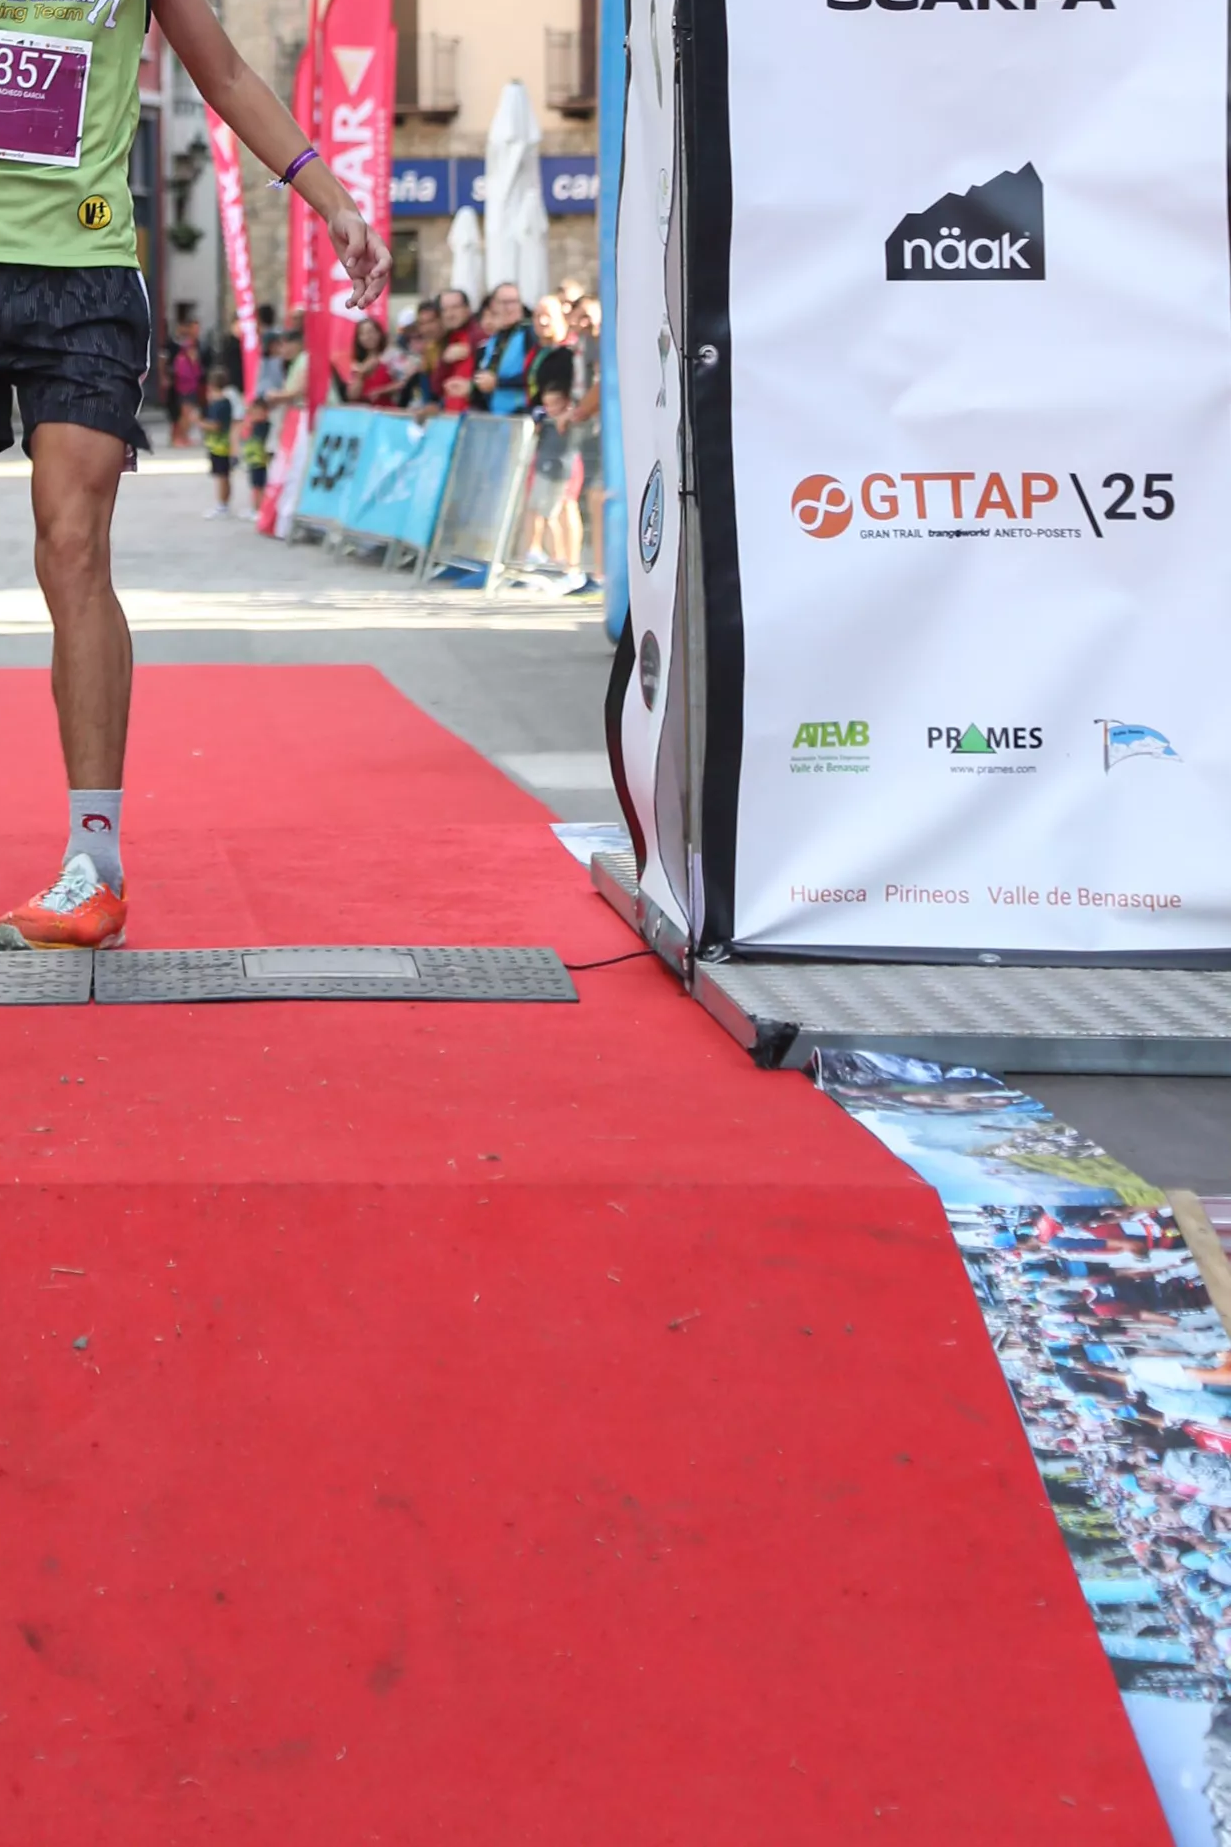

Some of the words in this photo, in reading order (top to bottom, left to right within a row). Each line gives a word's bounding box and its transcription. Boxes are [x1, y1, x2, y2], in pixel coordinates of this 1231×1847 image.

[33, 3, 83, 21] Team
[903, 227, 1031, 270] näak
[860, 472, 1059, 520] GTTAP
[860, 530, 890, 539] GRAN
[892, 529, 923, 538] TRAIL
[994, 529, 1081, 538] ANETO-POSETS
[792, 721, 870, 749] ATEVB
[789, 763, 812, 774] Valle
[813, 763, 824, 773] de
[826, 763, 870, 774] Benasque
[950, 765, 1037, 775] www.prames.com
[791, 885, 867, 903] Huesca
[885, 884, 970, 904] Pirineos
[988, 886, 1040, 906] Valle
[1046, 886, 1071, 906] de
[1078, 888, 1182, 913] Benasque
